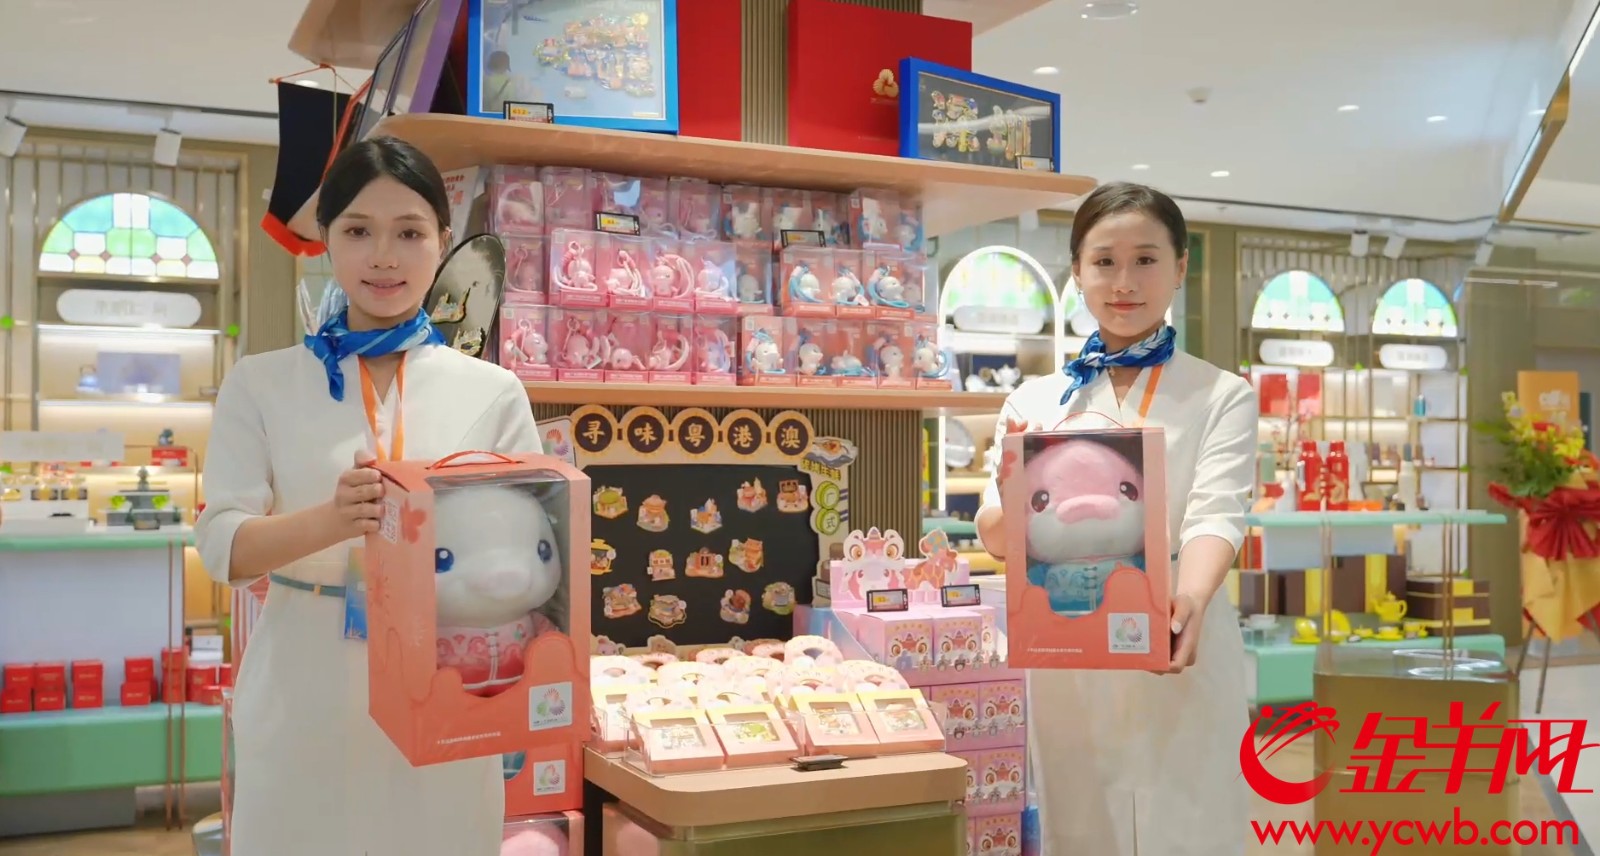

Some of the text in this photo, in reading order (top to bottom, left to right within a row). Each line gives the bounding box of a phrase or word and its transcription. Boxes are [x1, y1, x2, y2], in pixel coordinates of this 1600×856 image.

[582, 420, 801, 449] 寻味粤港澳
